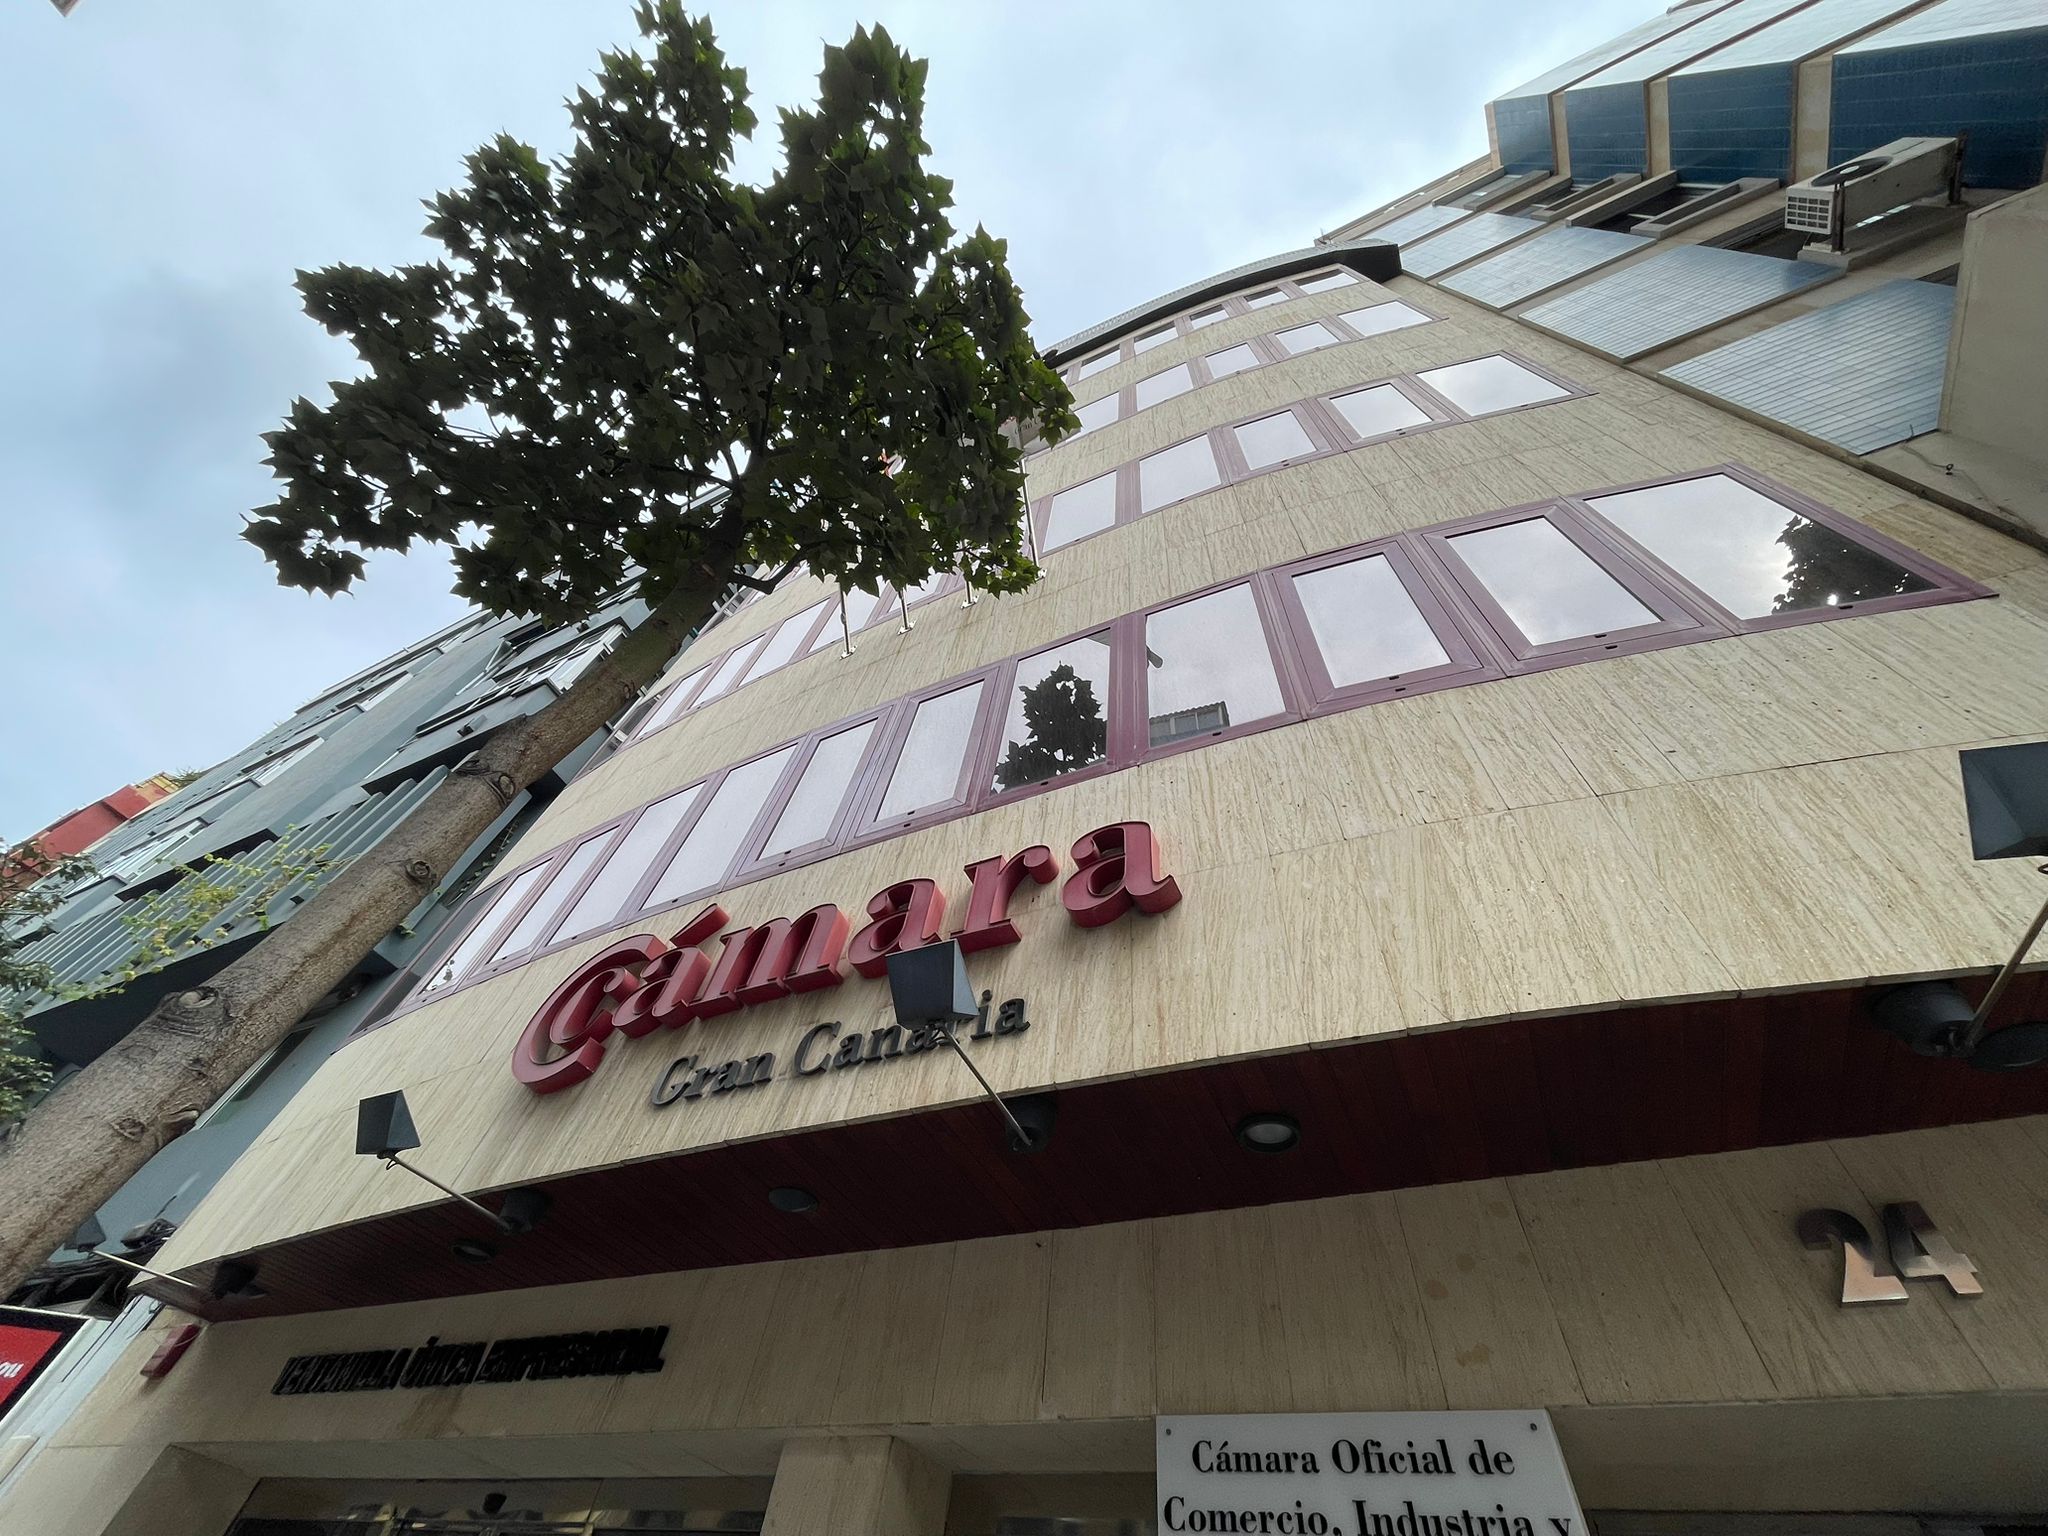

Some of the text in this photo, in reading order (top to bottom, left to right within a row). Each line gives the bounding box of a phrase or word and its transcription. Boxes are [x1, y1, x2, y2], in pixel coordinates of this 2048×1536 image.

[511, 820, 1183, 1095] Cámara
[650, 1050, 773, 1107] Gran
[1798, 1201, 1984, 1307] 24
[1191, 1438, 1516, 1475] Cámara Oficial de
[1163, 1496, 1342, 1536] Comercio,
[1354, 1499, 1535, 1536] Industria
